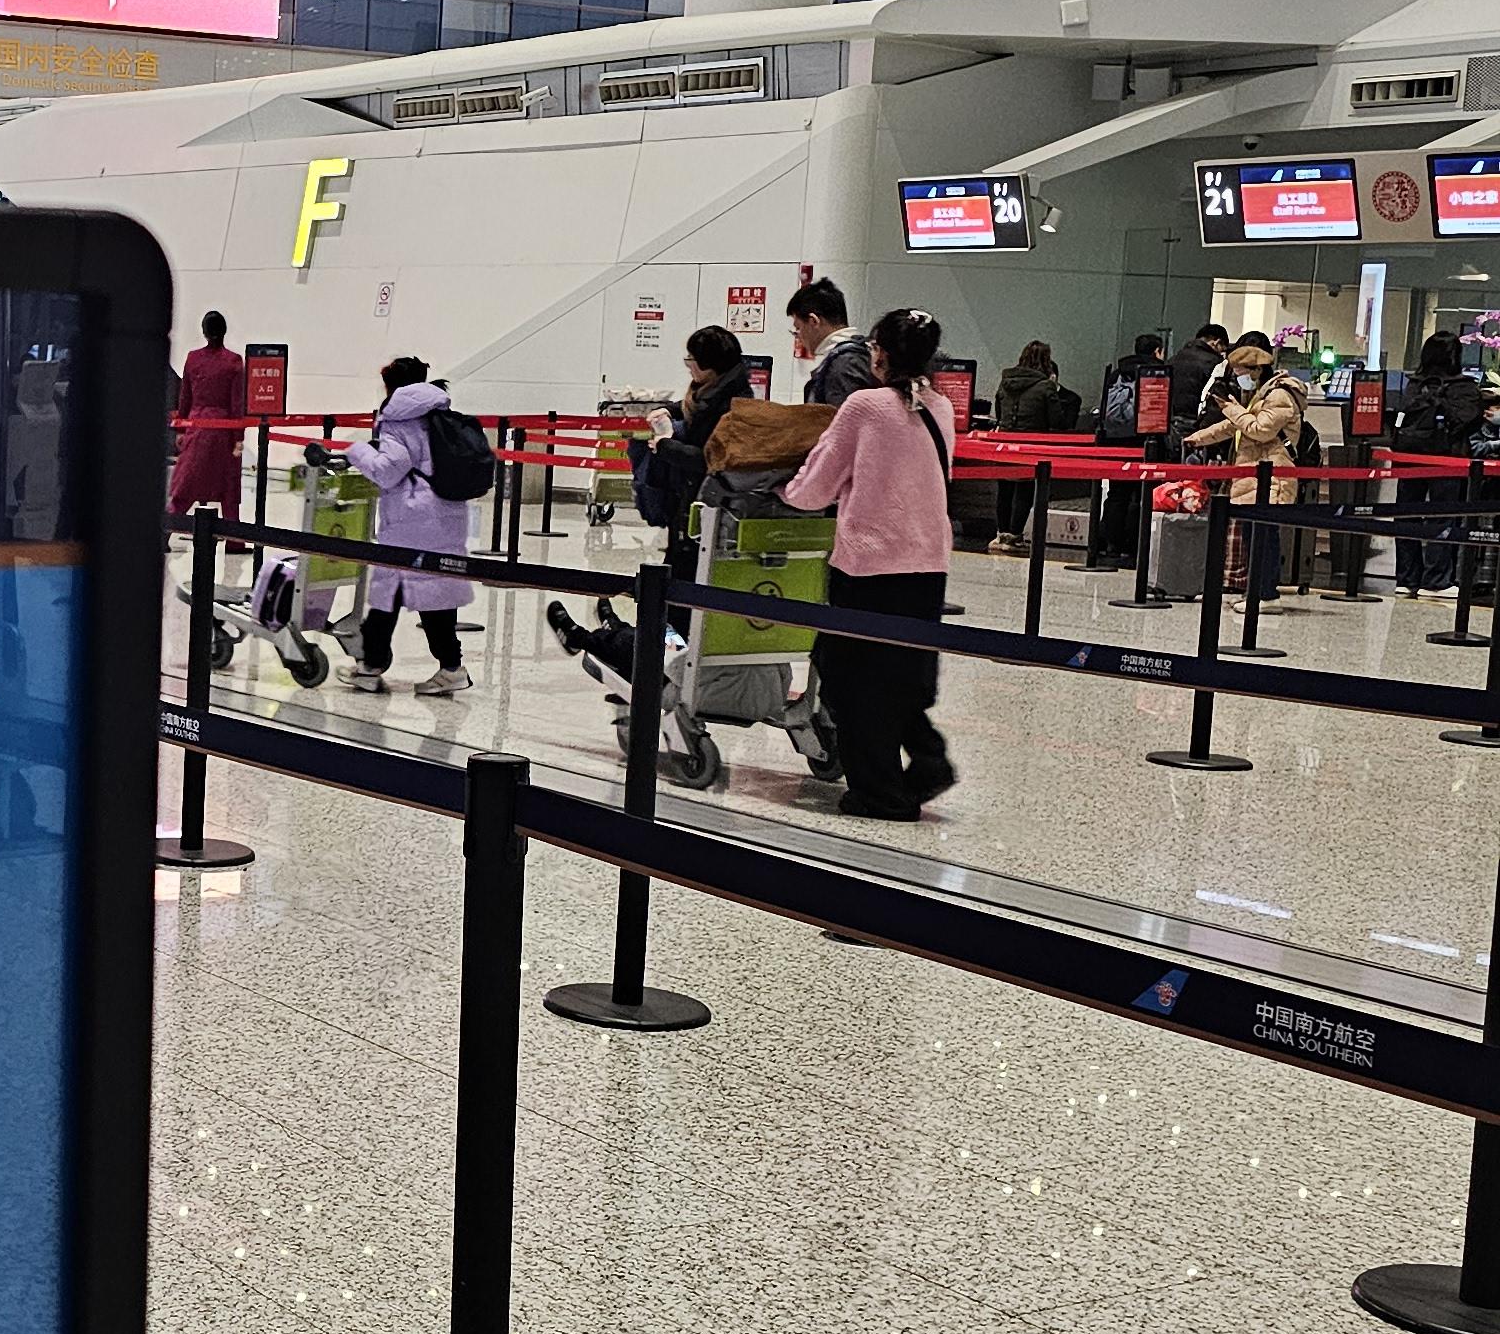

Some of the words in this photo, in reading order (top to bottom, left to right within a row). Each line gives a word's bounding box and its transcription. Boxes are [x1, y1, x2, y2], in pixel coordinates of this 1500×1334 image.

[2, 73, 58, 91] Domestic
[291, 158, 352, 268] F
[993, 198, 1021, 223] 20
[1204, 188, 1234, 215] 21
[1120, 664, 1138, 674] CHINA
[1139, 666, 1171, 677] SOUTHERN
[1121, 654, 1172, 670] 中国南方航空
[1256, 1001, 1375, 1052] 中国南方航空
[1253, 1024, 1295, 1047] CHINA
[1299, 1036, 1374, 1068] SOUTHERN
